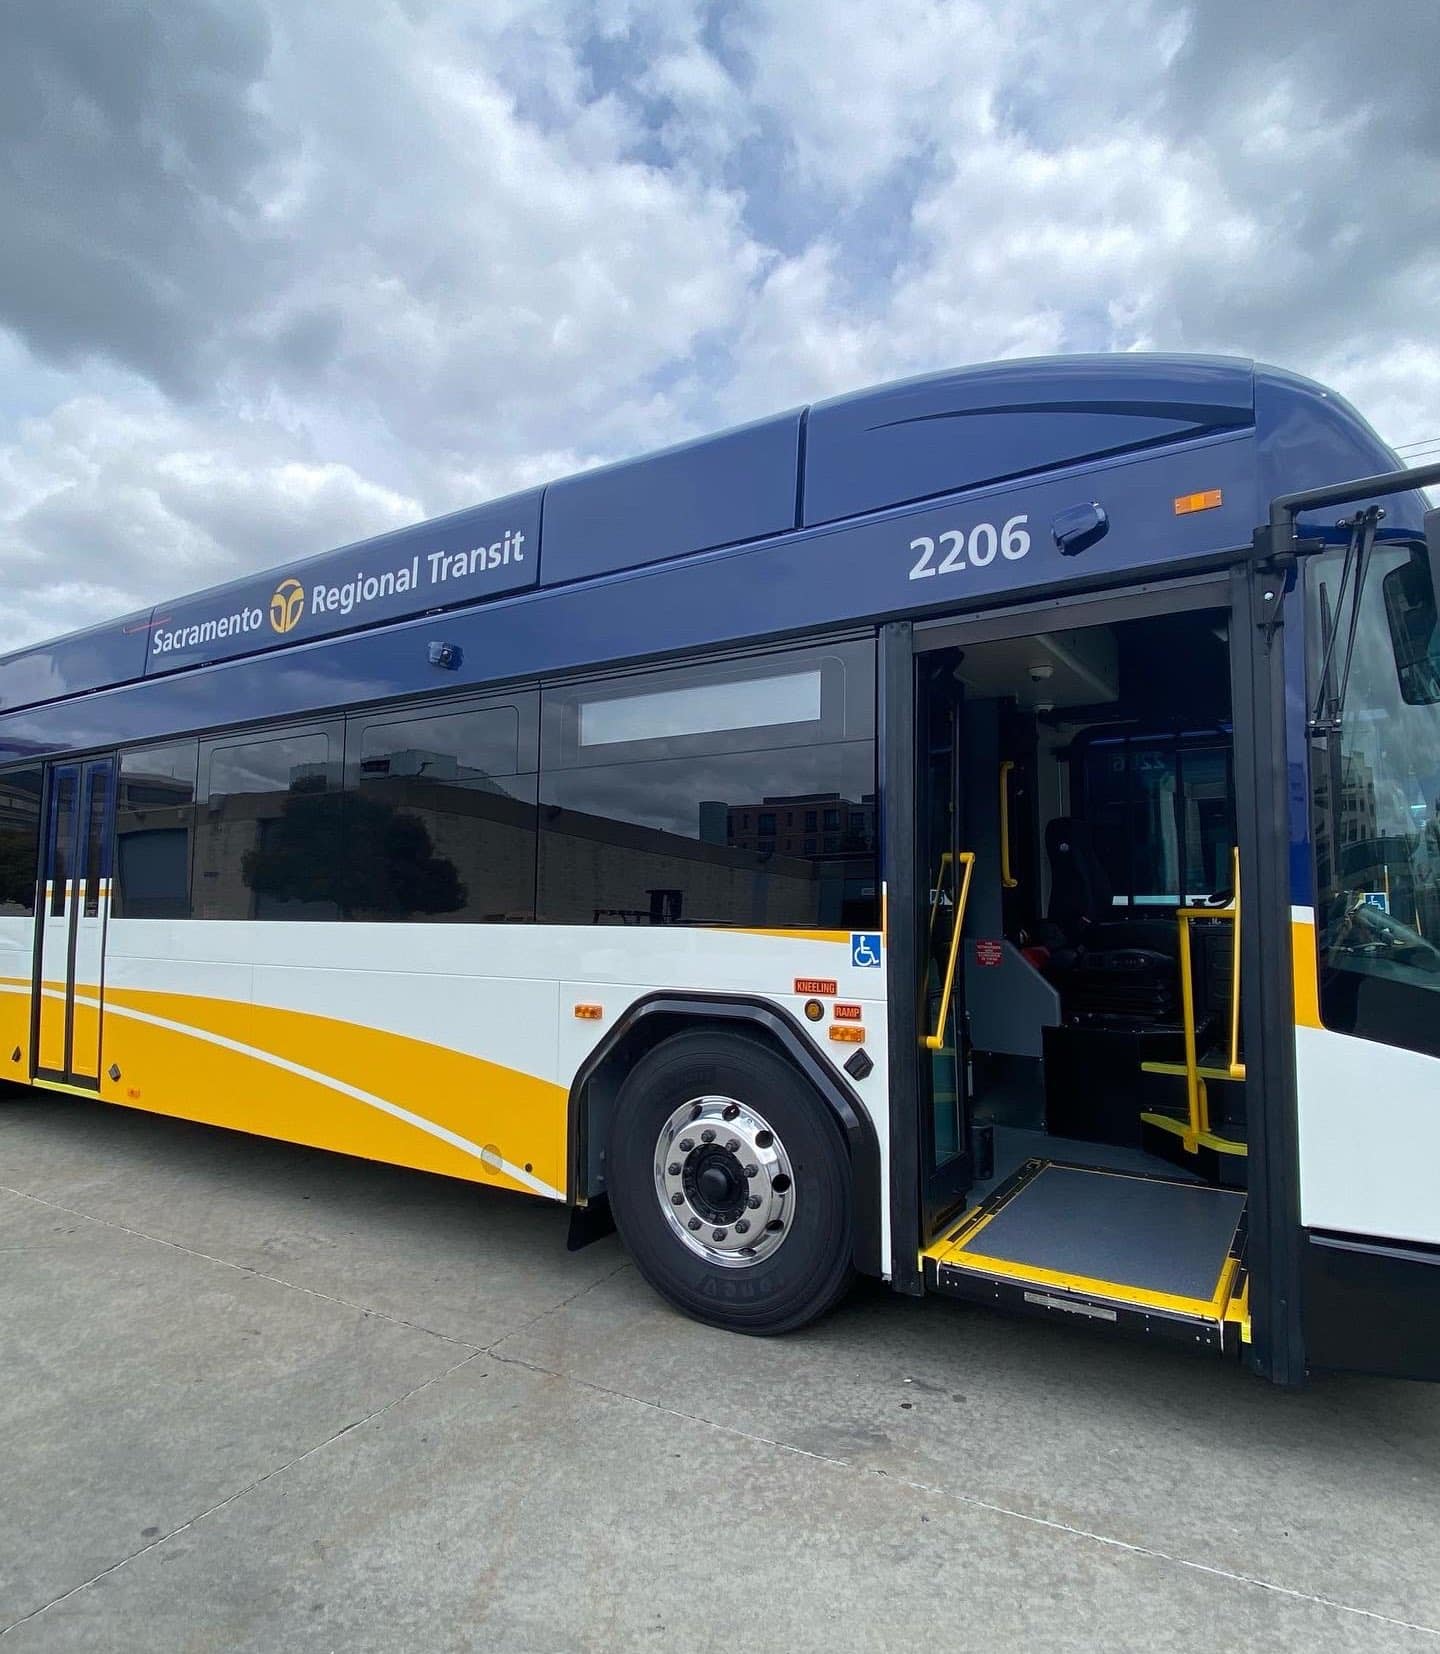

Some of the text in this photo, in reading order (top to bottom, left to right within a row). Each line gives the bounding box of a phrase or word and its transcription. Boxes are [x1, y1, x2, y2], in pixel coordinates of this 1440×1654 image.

[909, 514, 1031, 580] 2206
[153, 530, 525, 654] Sacramento Regional Transit
[798, 981, 835, 993] KNEELING
[836, 1006, 860, 1017] RAMP
